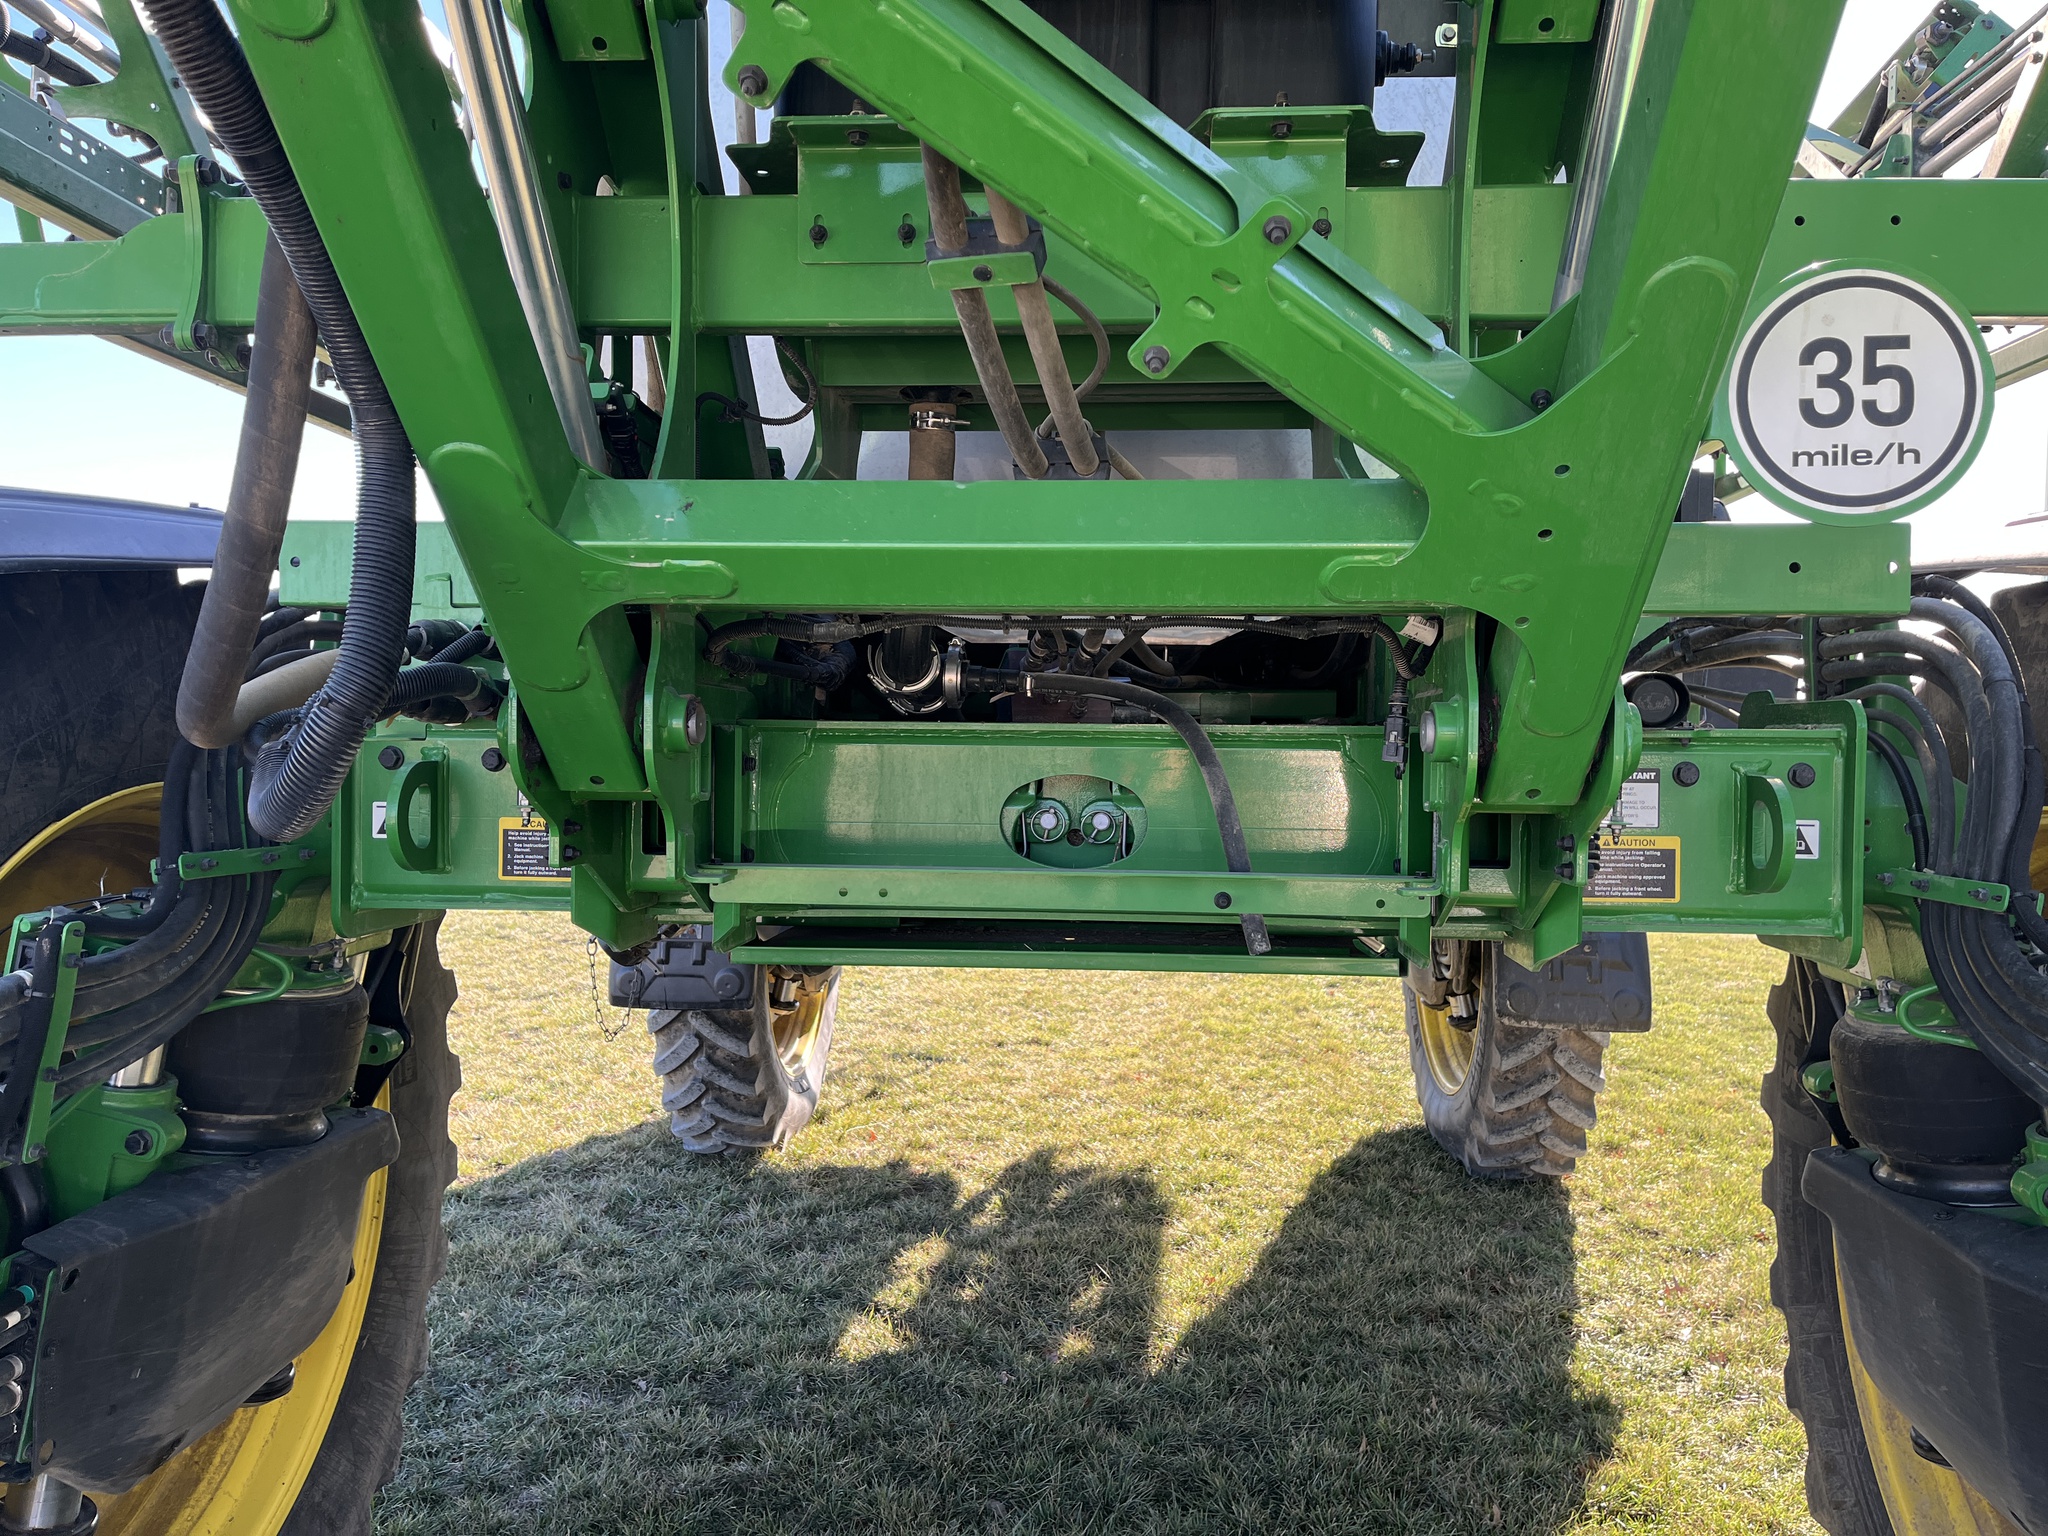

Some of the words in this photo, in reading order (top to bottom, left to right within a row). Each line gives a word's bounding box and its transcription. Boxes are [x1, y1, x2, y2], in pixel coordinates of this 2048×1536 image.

[1798, 334, 1915, 429] 35
[1792, 442, 1921, 467] mile/h
[1619, 839, 1656, 847] AUTION
